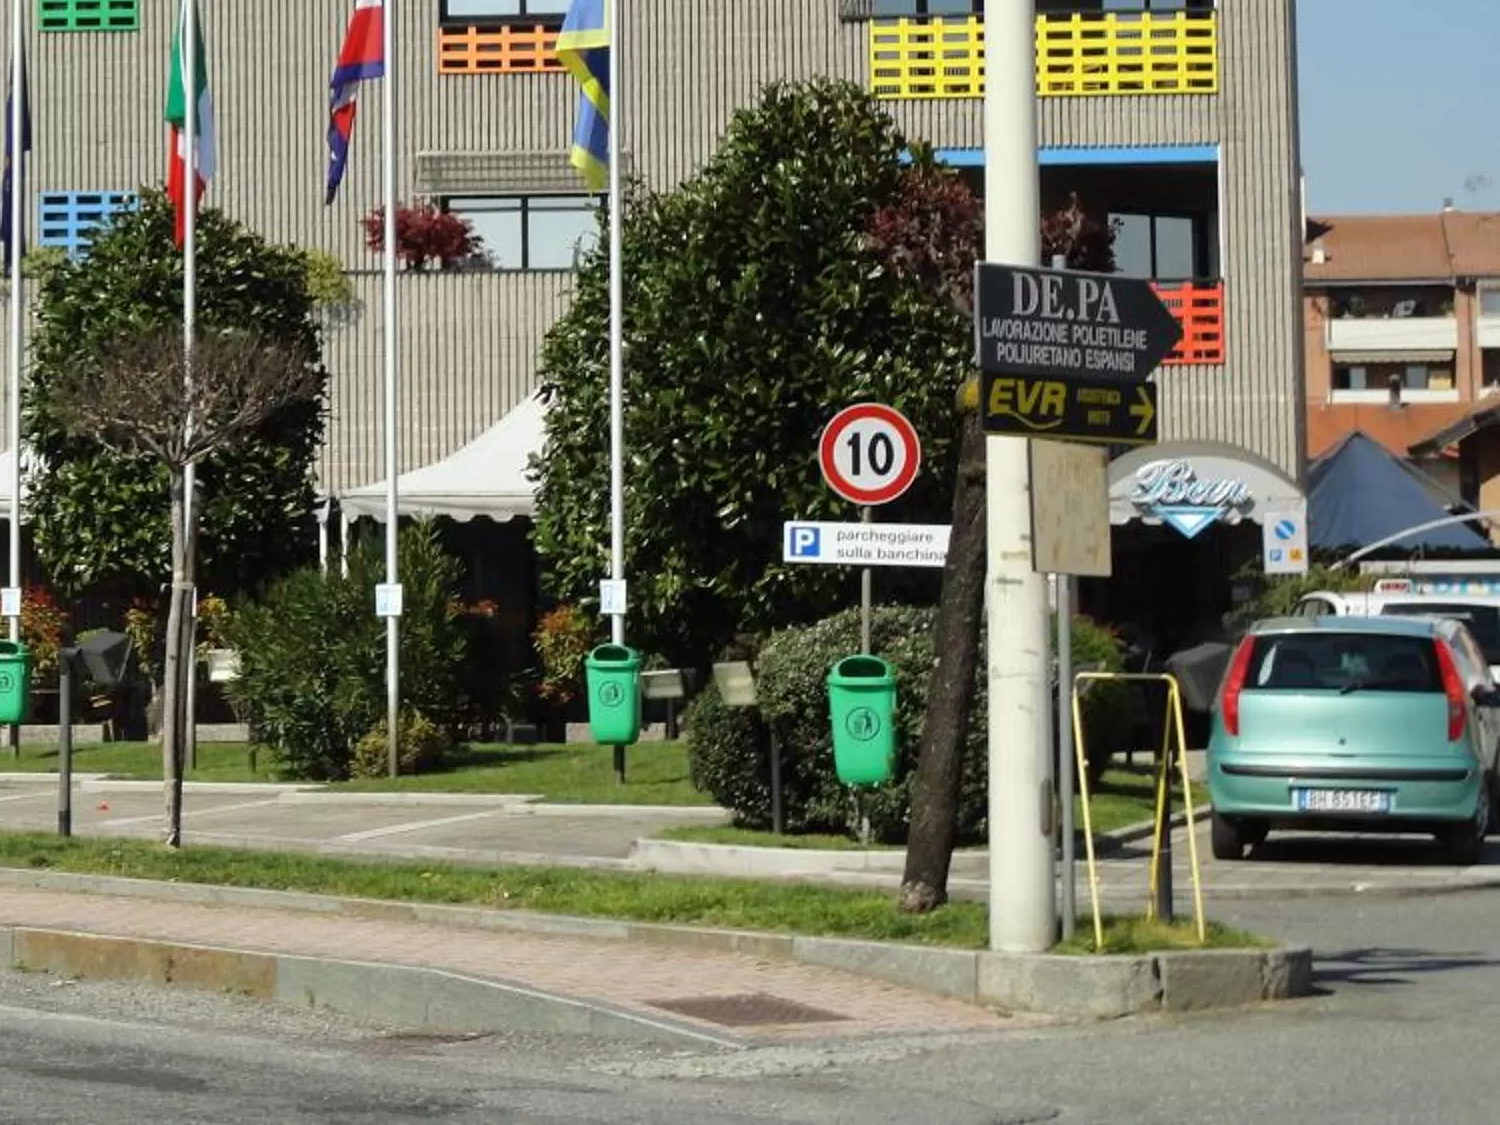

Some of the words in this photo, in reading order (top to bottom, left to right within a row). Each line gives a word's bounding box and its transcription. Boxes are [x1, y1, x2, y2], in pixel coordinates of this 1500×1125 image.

[1011, 271, 1121, 324] DE.PA
[982, 316, 1069, 345] LAVORAZIONE
[1072, 325, 1149, 351] POLIETILENE
[996, 342, 1081, 368] POLIURETANO
[1085, 348, 1136, 372] ESPANSI
[988, 378, 1068, 416] EVR
[847, 431, 895, 476] 10
[794, 528, 816, 556] P
[836, 527, 933, 545] parcheggiare
[836, 546, 873, 559] sulla
